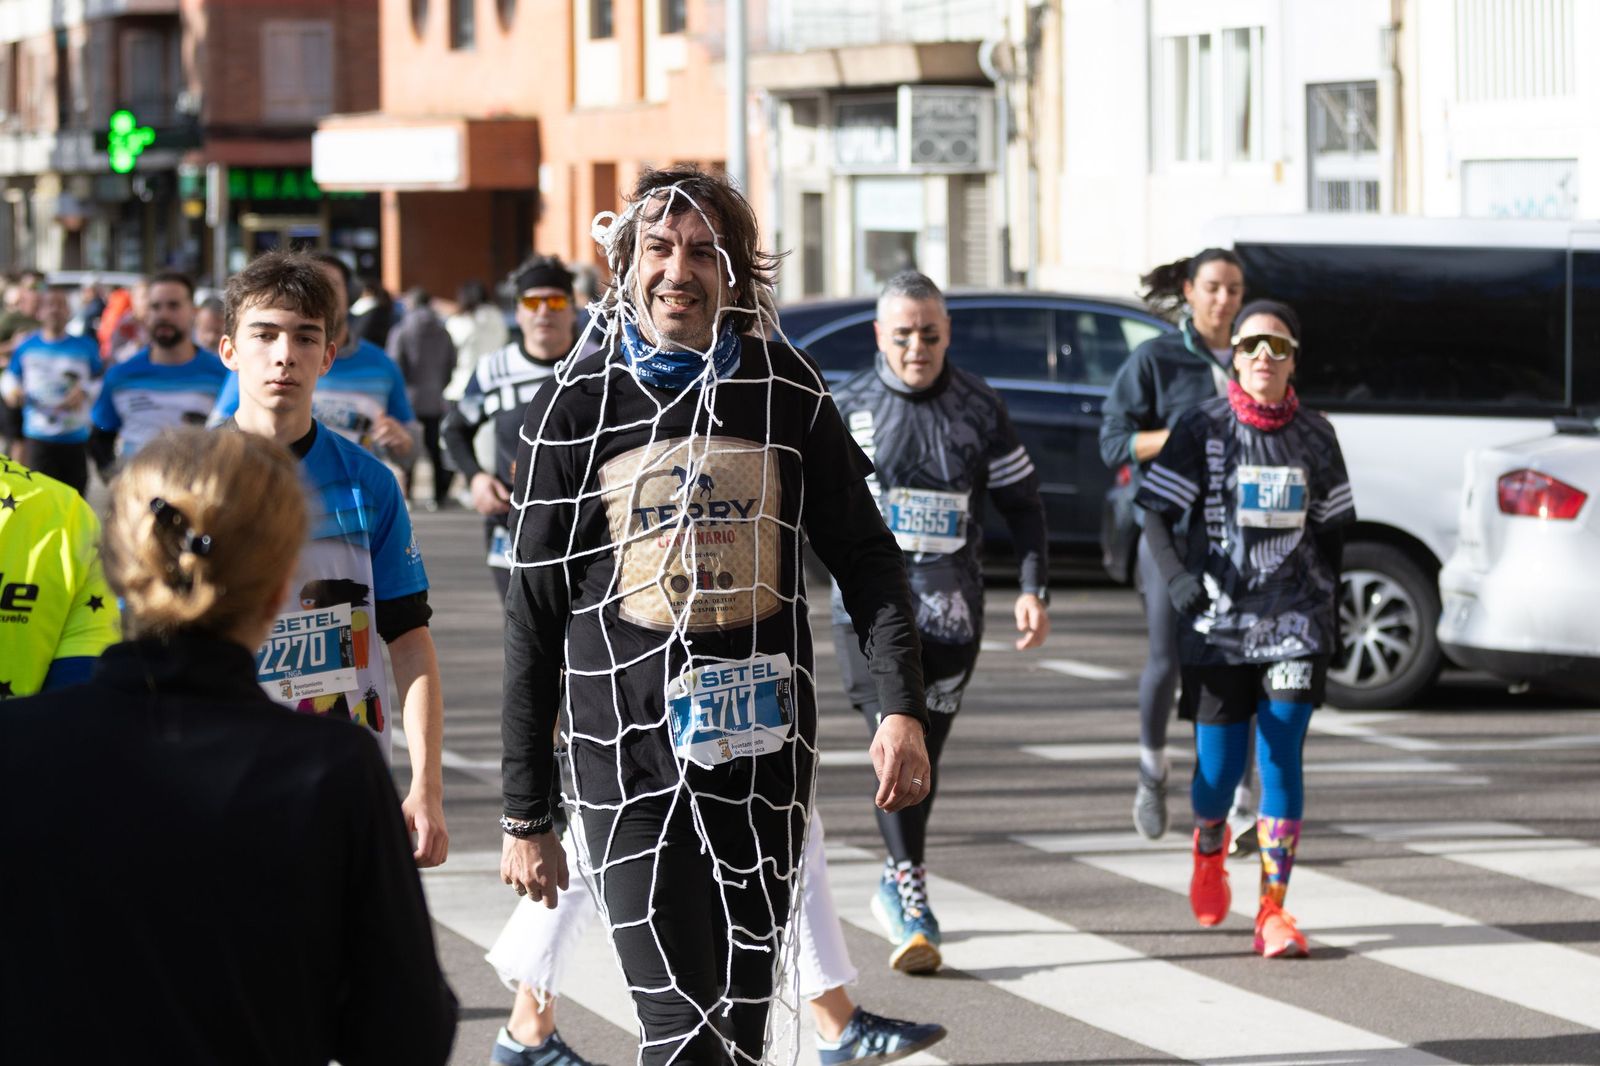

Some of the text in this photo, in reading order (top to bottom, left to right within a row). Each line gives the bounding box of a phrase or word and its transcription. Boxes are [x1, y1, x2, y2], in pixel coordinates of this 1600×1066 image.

[632, 499, 757, 532] TERRY
[0, 572, 40, 613] e
[271, 612, 341, 634] SETEL
[257, 631, 327, 676] 2270
[700, 662, 779, 689] SETEL
[693, 684, 757, 734] 5717
